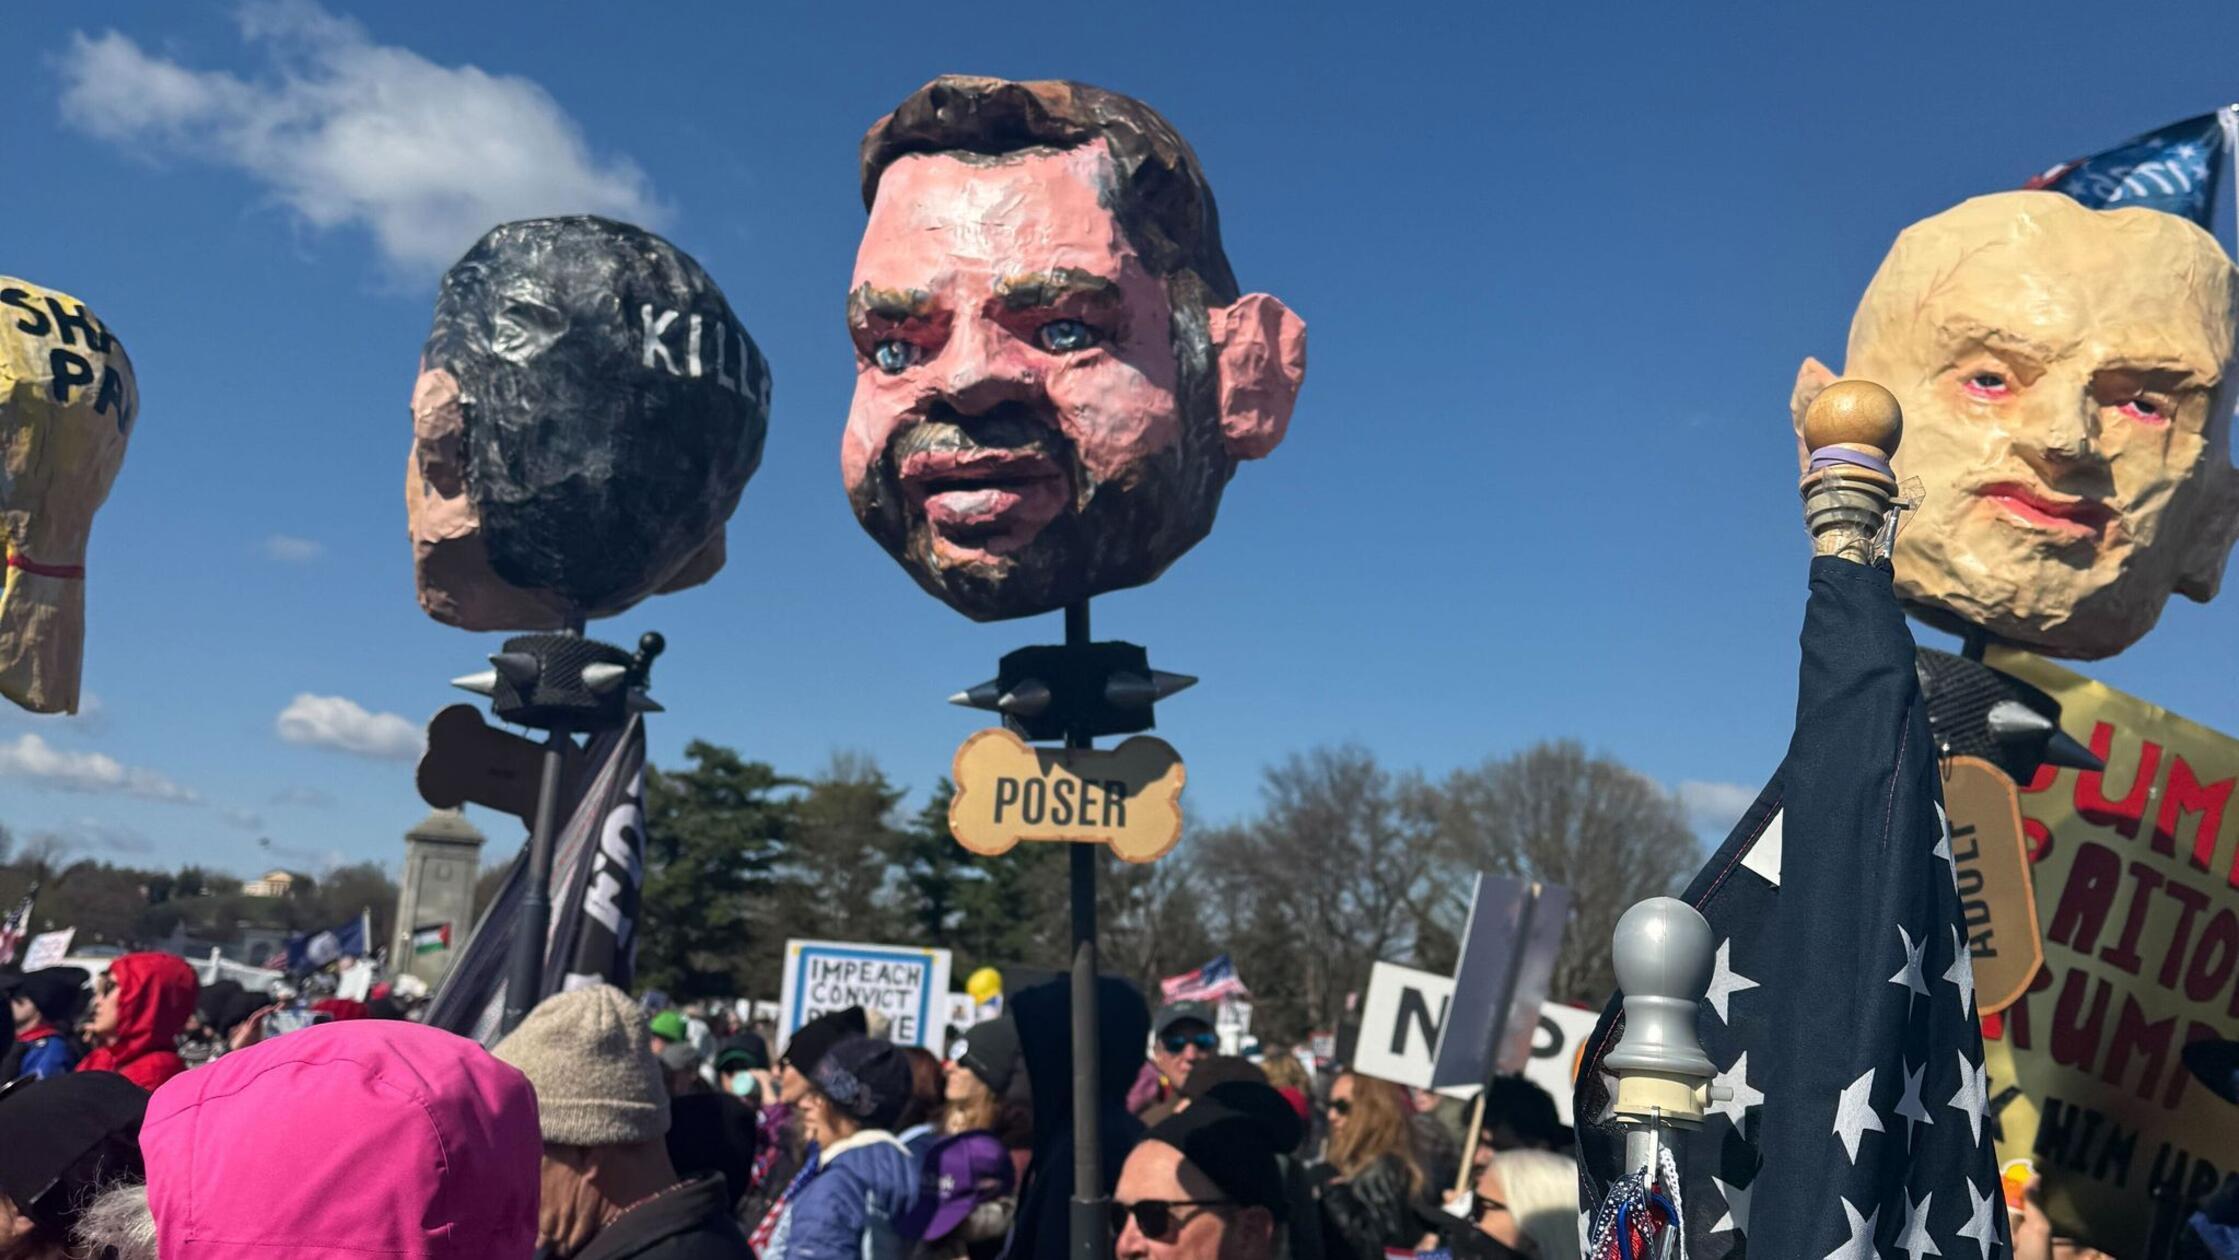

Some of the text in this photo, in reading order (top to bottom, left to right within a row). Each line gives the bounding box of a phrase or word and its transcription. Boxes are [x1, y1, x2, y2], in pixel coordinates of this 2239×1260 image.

[993, 776, 1127, 828] POSER
[2016, 720, 2239, 890] UM
[811, 982, 912, 1009] CONVICT
[812, 958, 921, 986] IMPEACH
[2036, 1096, 2138, 1189] HIM
